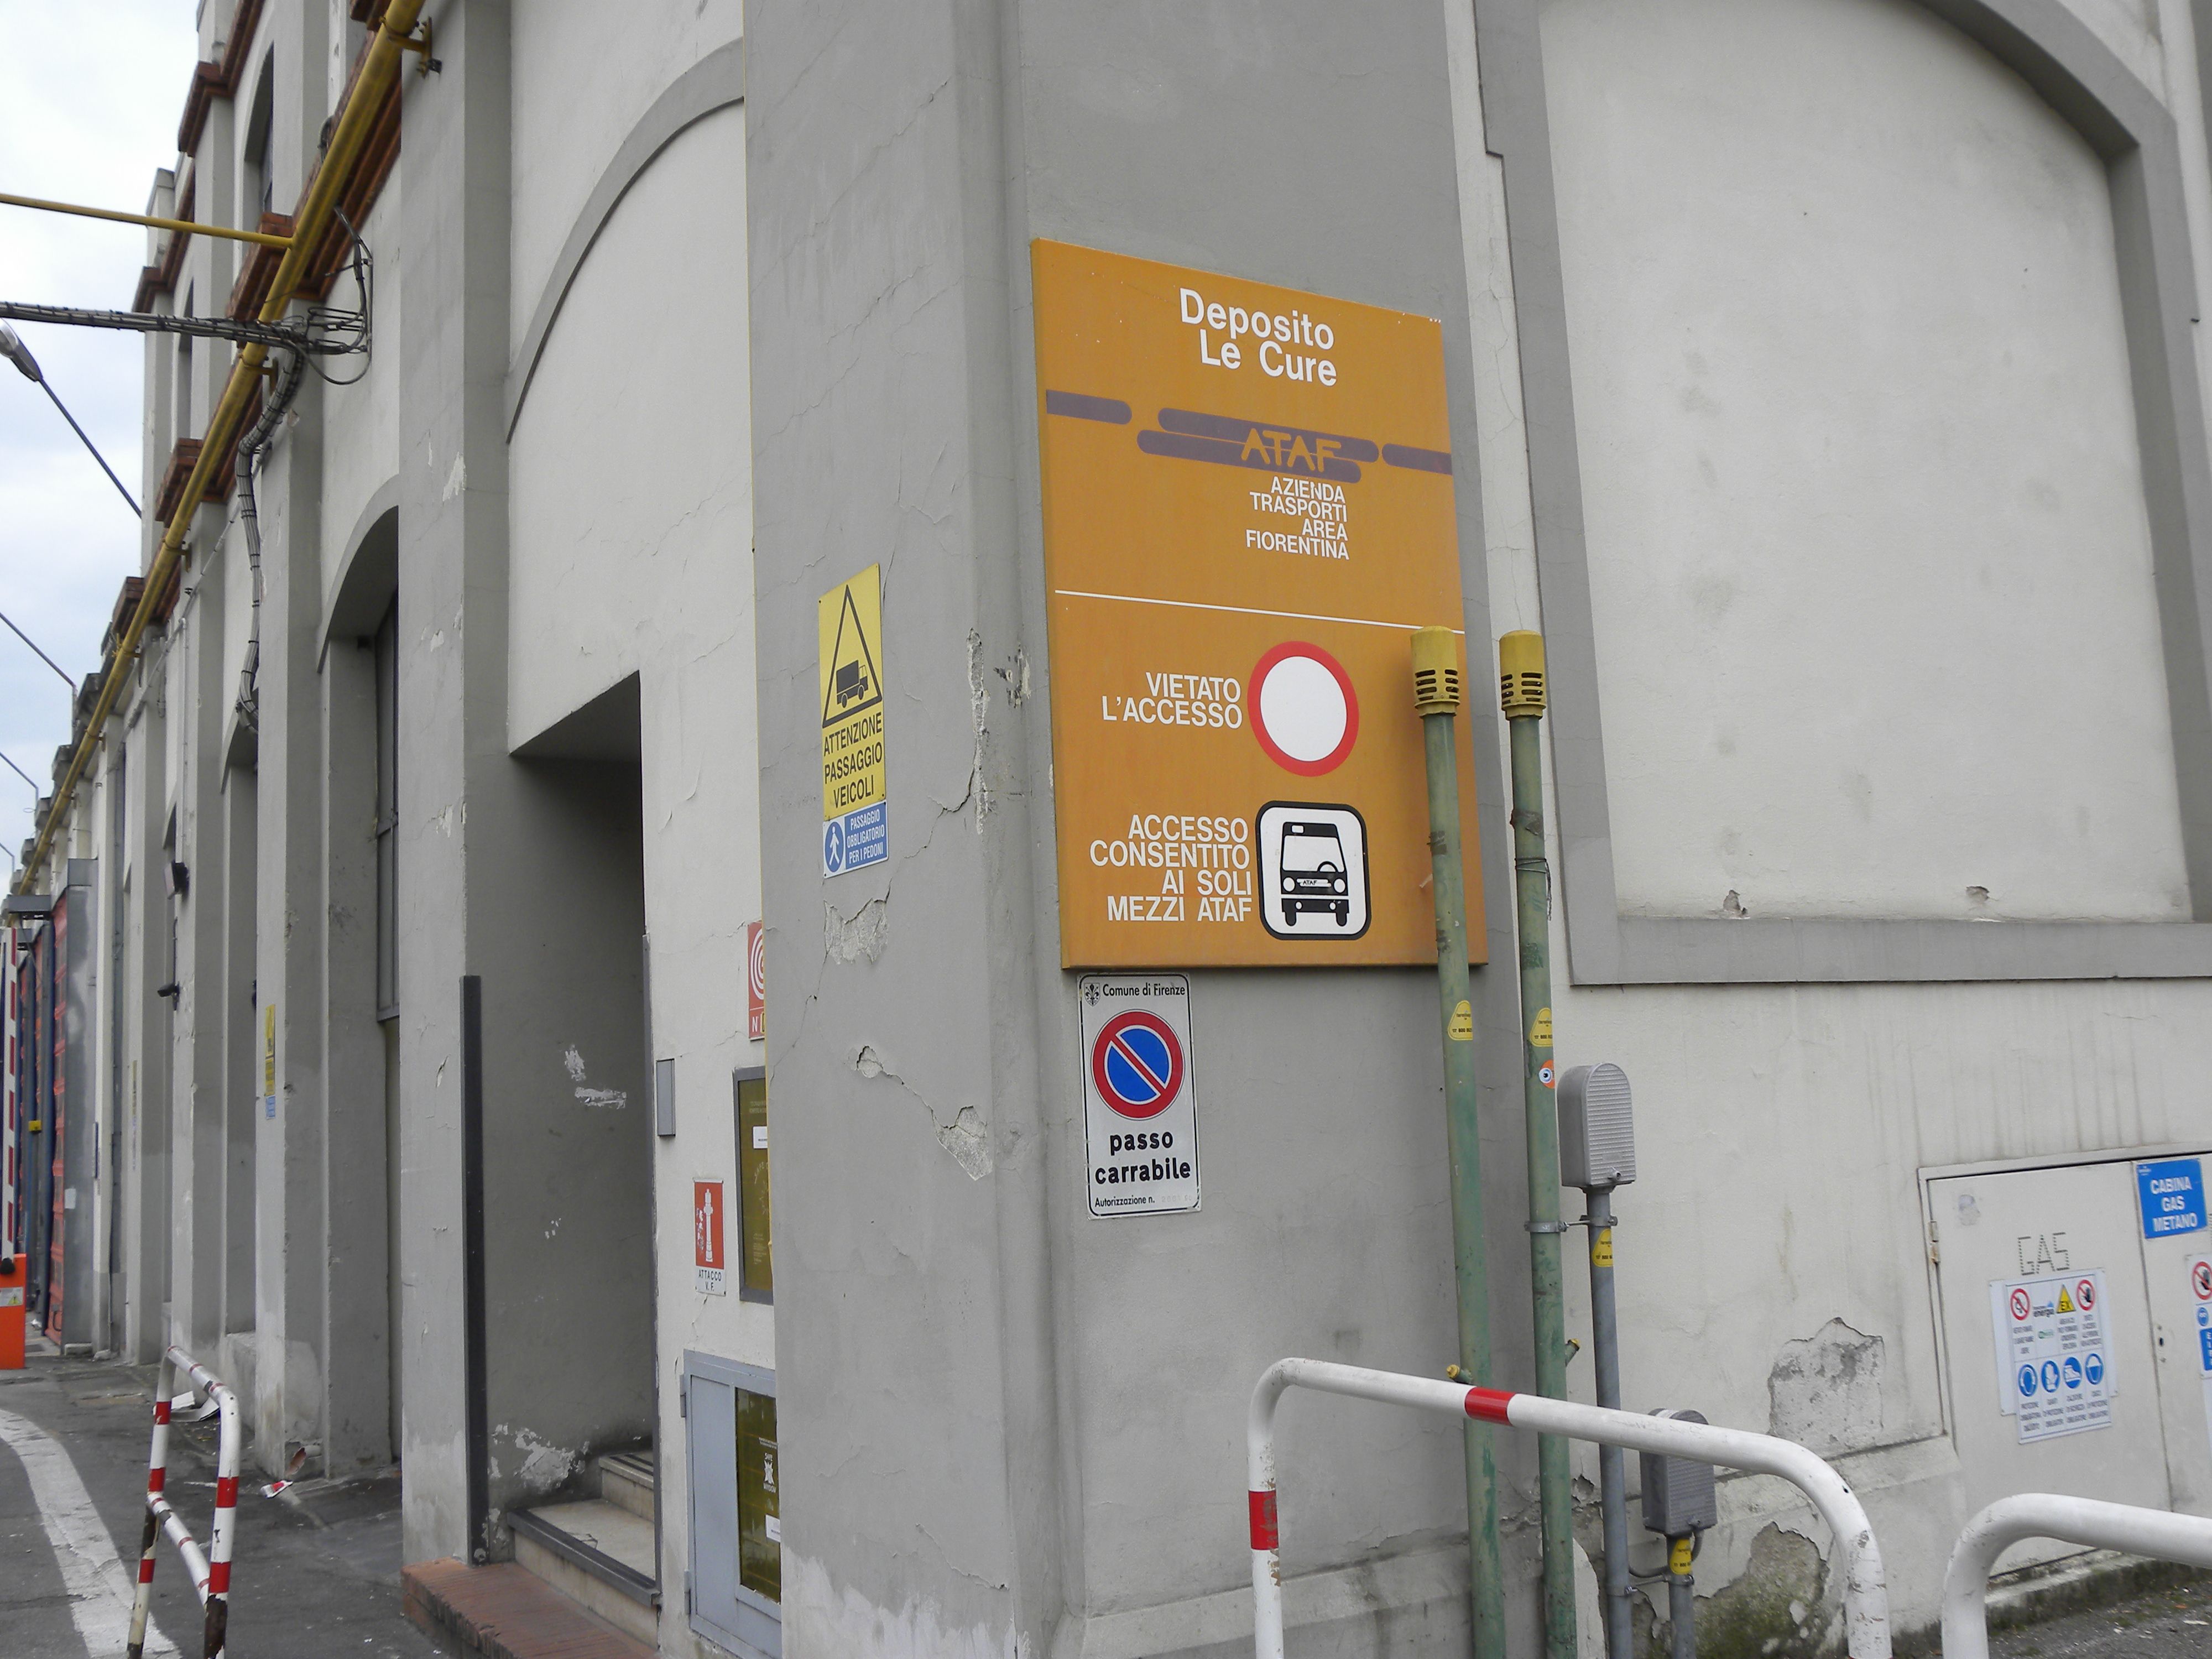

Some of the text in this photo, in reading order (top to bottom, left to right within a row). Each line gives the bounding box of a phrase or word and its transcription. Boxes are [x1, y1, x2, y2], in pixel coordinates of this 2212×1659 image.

[1180, 288, 1335, 350] Deposito
[1199, 328, 1337, 387] Le Cure
[1241, 427, 1341, 472] ATAF
[1271, 476, 1345, 504] AZIENDA
[1249, 492, 1348, 523] TRASPORTI
[1302, 518, 1348, 541] AREA
[1246, 530, 1349, 560] FIORENTINA
[1145, 672, 1241, 703] VIETATO
[1102, 695, 1243, 729] L'ACCESSO
[823, 712, 882, 757] ATTENZIONE
[825, 742, 883, 784] PASSAGGIO
[833, 775, 874, 808] VEICOLI
[850, 808, 880, 831] PASSAGGIO
[1128, 814, 1248, 844] ACCESSO
[847, 824, 885, 848] OBBLIGATORIO
[849, 841, 883, 864] PER I PEDONI
[1089, 839, 1250, 868] CONSENTITO
[1162, 869, 1252, 896] AI SOLI
[1107, 896, 1253, 922] MEZZI ATAF
[1102, 983, 1186, 996] Comune di Firenze
[1109, 1131, 1173, 1156] passo
[1094, 1157, 1191, 1185] carrabile
[2150, 1176, 2193, 1194] CABINA
[1095, 1196, 1146, 1208] Autorizzazione
[2162, 1195, 2185, 1212] GAS
[2152, 1212, 2198, 1232] METANO
[2017, 1232, 2070, 1276] GAS
[698, 1269, 722, 1282] ATTACCO
